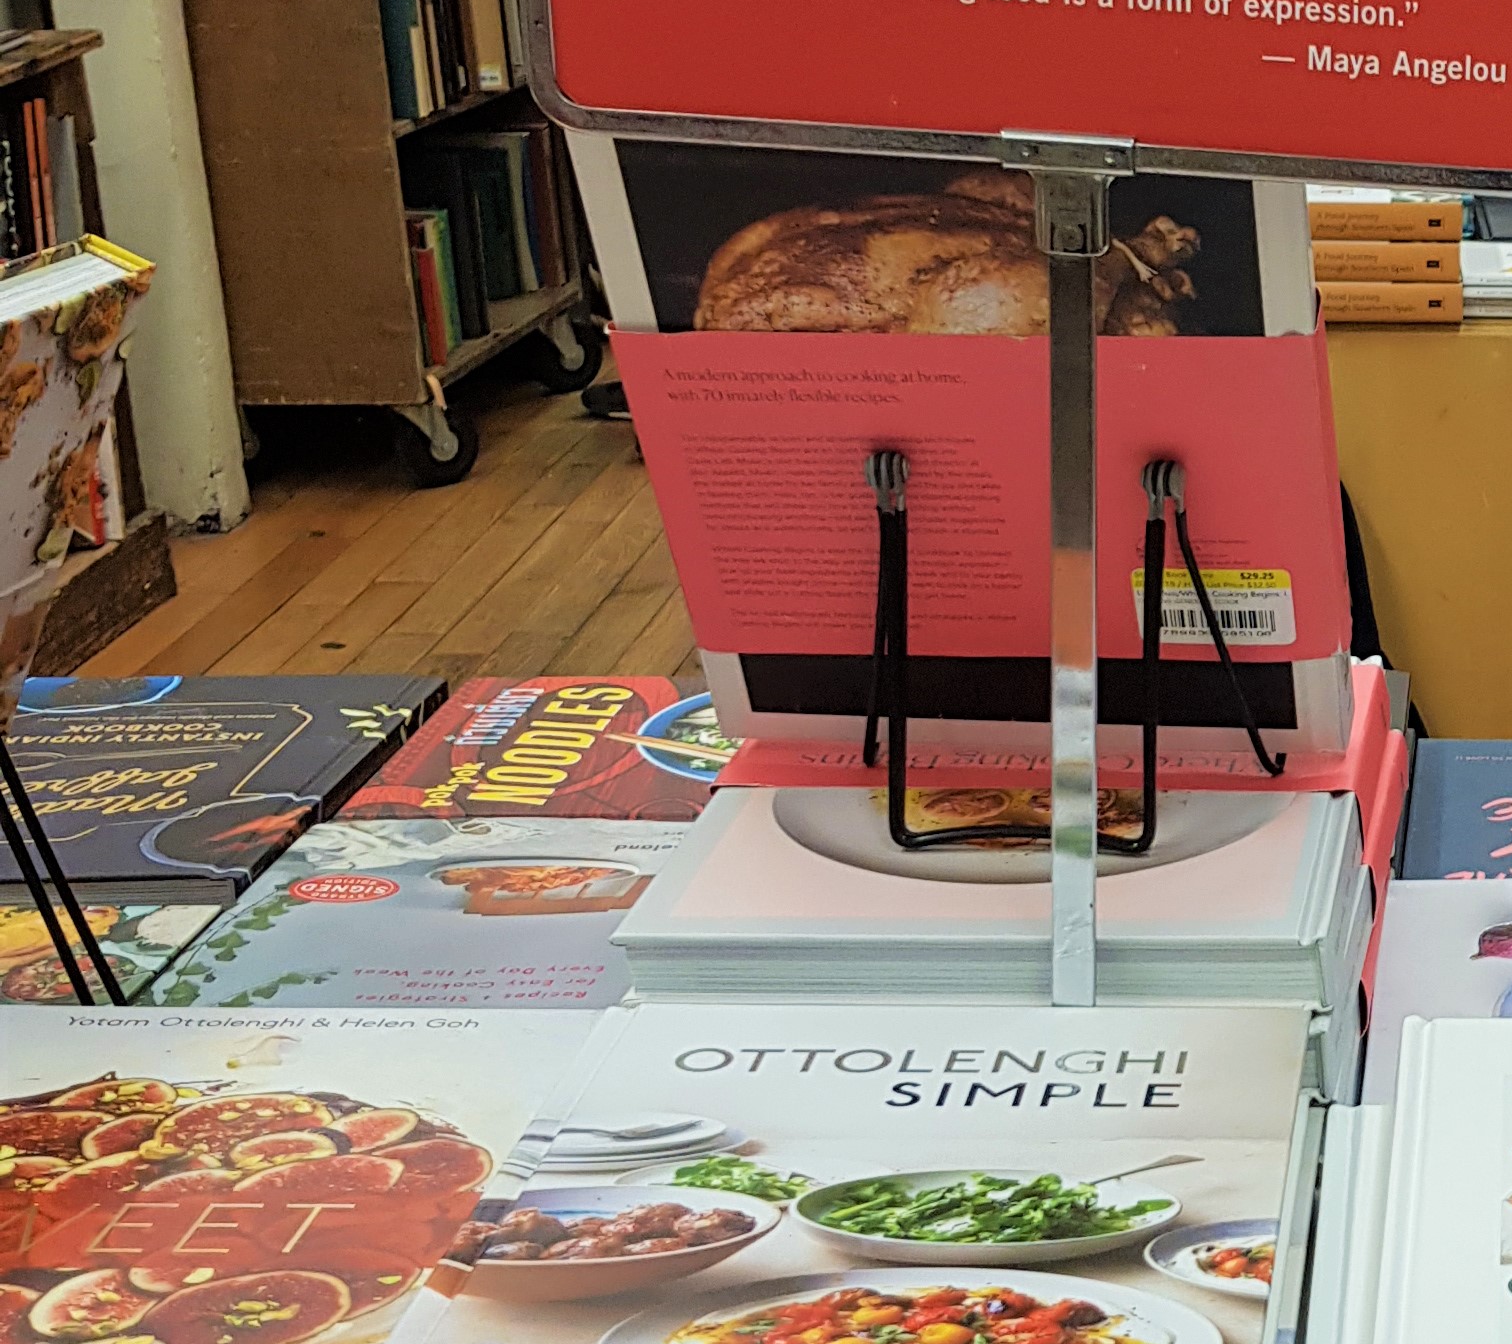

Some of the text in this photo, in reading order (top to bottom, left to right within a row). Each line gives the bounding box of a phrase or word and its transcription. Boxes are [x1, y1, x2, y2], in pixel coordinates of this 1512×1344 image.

[1308, 44, 1507, 85] Maya Angelou
[1240, 572, 1274, 580] $29.25
[63, 722, 221, 734] COOKBOOK
[104, 731, 263, 744] INSTANTLY
[467, 686, 634, 806] NOODLES
[421, 762, 485, 808] pok pok
[300, 883, 389, 896] SIGNED
[352, 968, 409, 978] Week
[422, 968, 455, 978] the
[464, 968, 486, 977] of
[498, 965, 537, 975] Day
[354, 989, 588, 1004] Recipes Strategies
[65, 1014, 480, 1031] Yotam Ottolenghi & Helen Goh
[674, 1047, 1189, 1075] OTTOLENGHI
[885, 1081, 1182, 1108] SIMPLE
